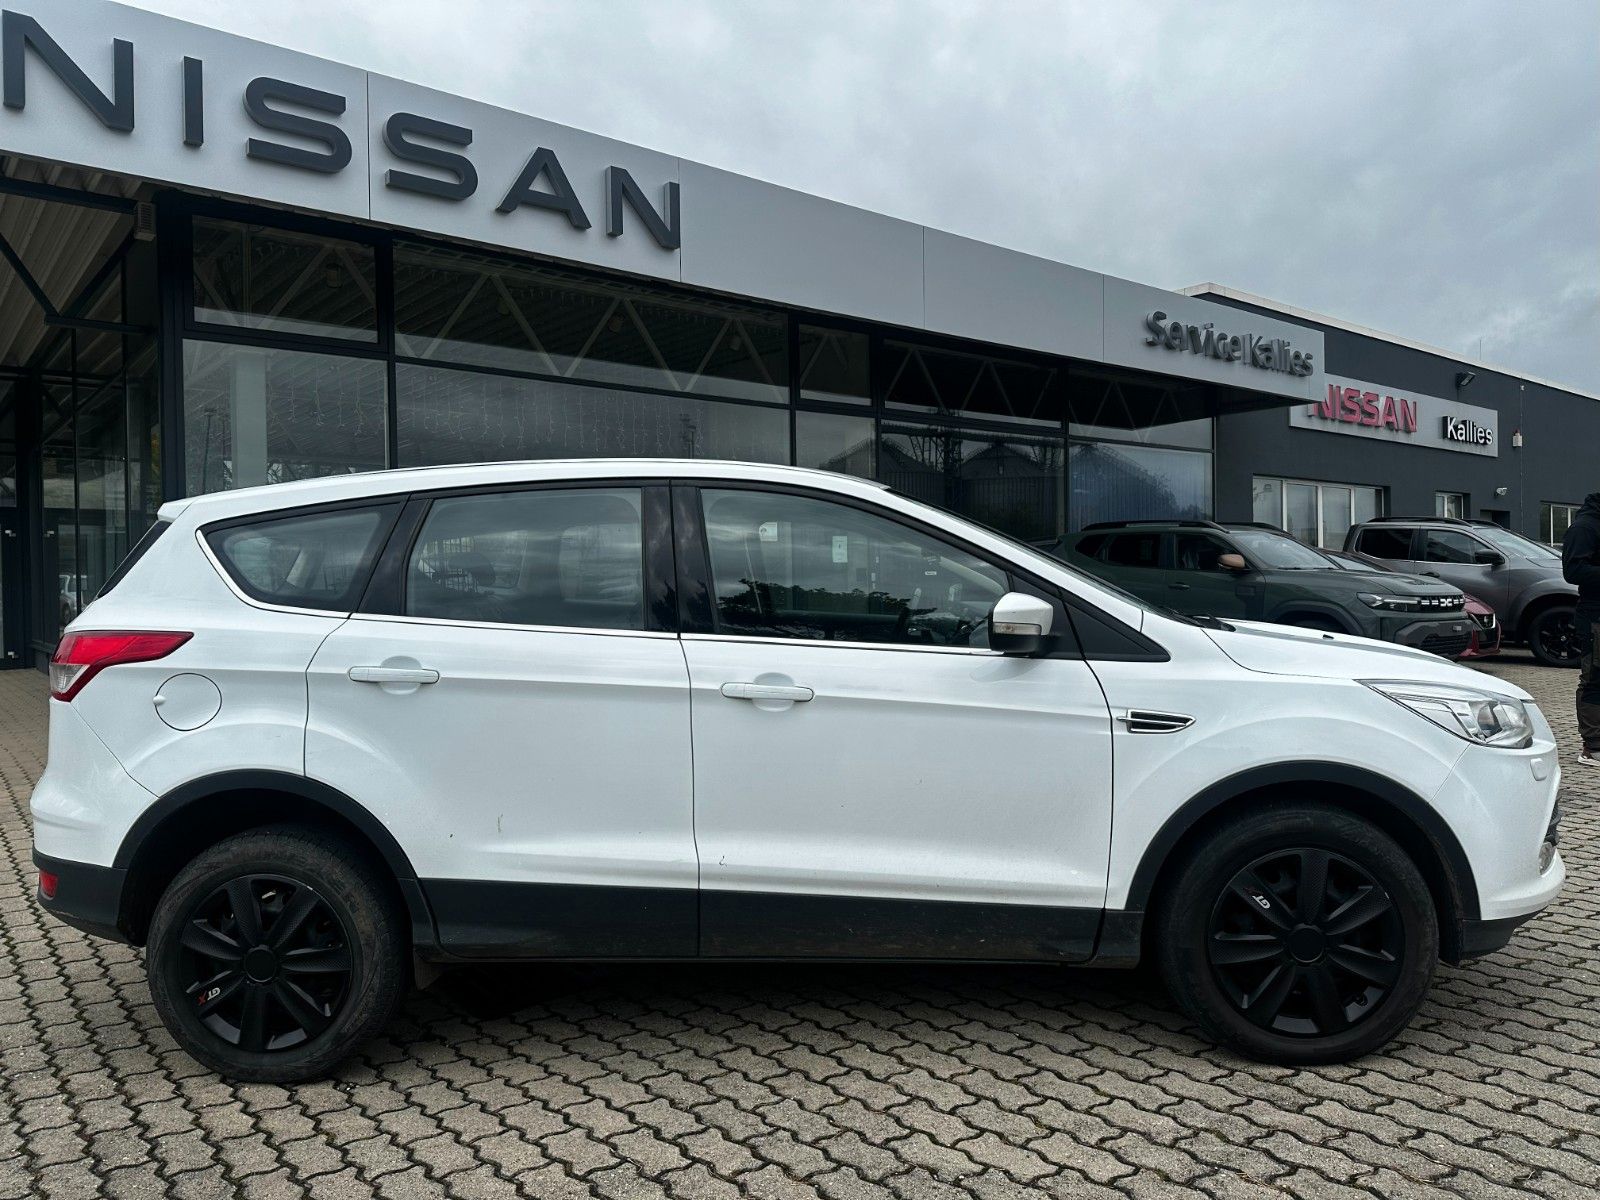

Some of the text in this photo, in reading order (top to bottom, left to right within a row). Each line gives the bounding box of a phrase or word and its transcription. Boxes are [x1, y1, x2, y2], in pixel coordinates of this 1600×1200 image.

[2, 8, 681, 250] NISSAN
[1310, 383, 1493, 446] NISSAN Kallies
